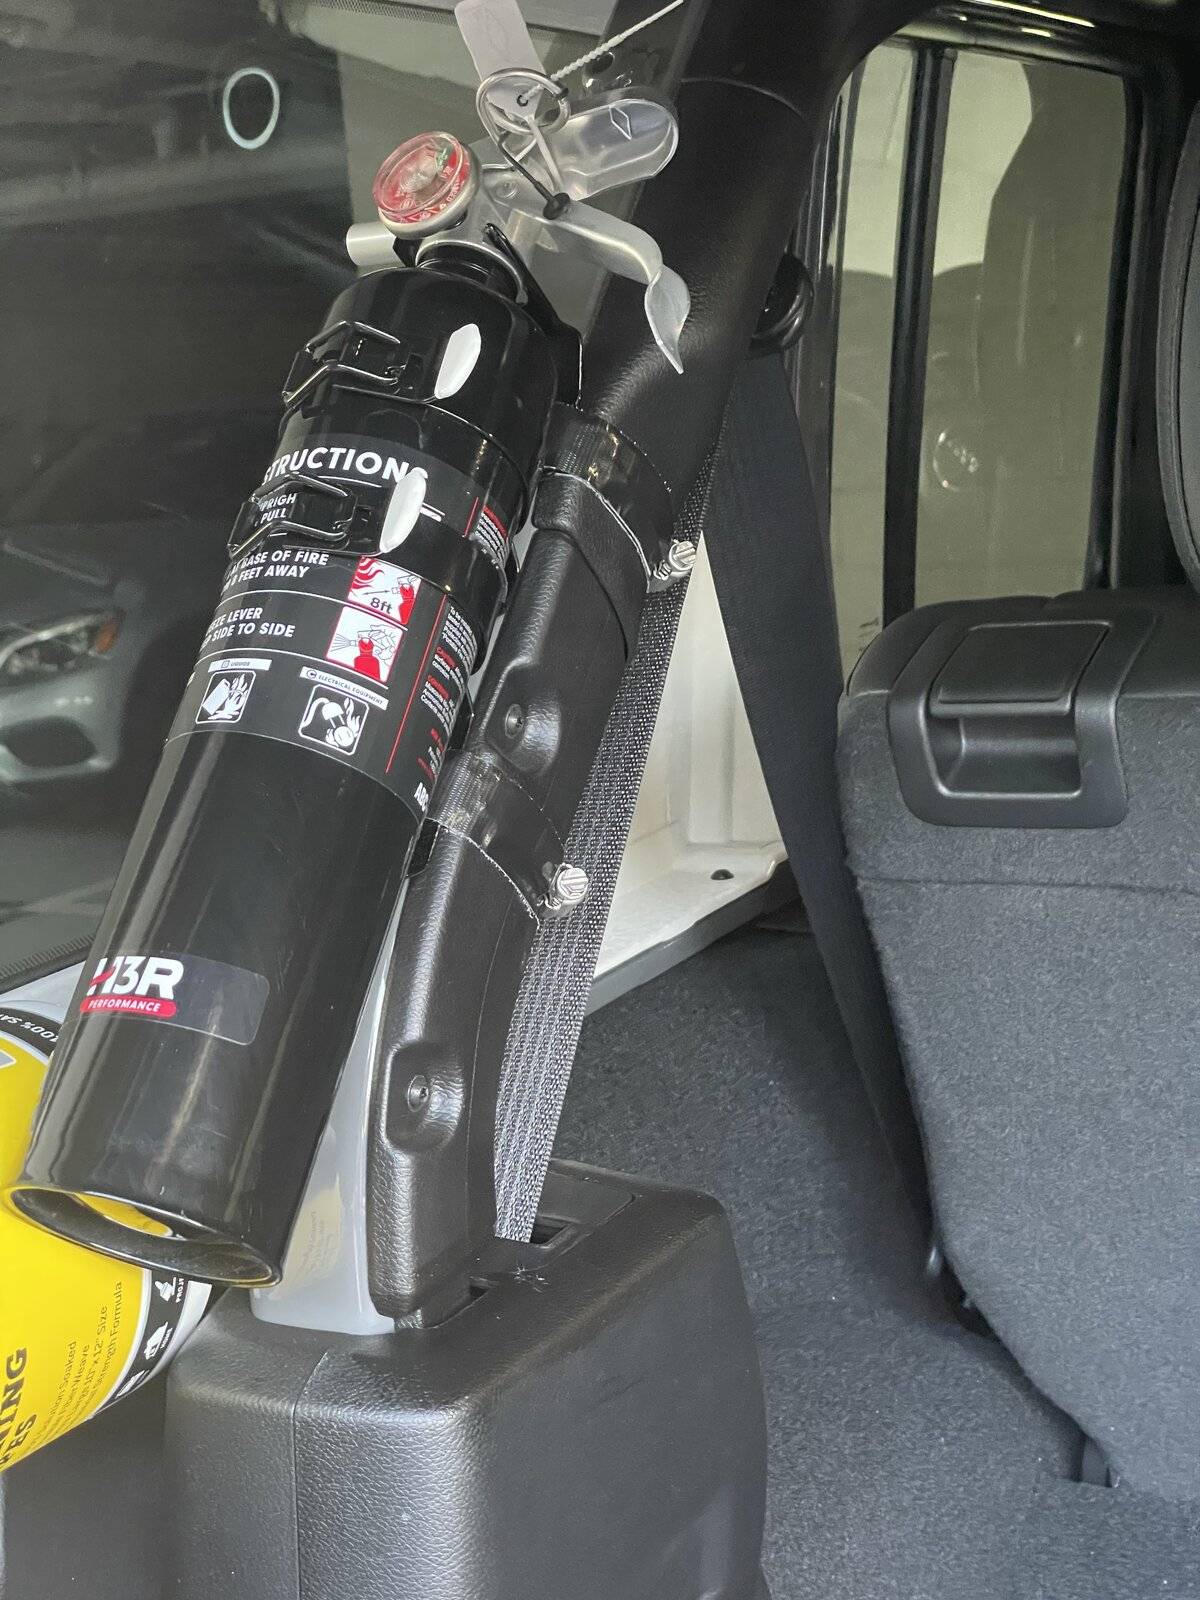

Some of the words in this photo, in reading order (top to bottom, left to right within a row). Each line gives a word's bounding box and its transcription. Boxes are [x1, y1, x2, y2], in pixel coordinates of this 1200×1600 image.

[261, 446, 428, 486] STRUCTION
[260, 509, 287, 525] PULL
[271, 550, 292, 562] OF
[294, 551, 330, 566] FIRE
[263, 564, 310, 578] AWAY
[370, 597, 392, 614] 8ft
[227, 607, 264, 624] LEVER
[211, 624, 236, 642] SIDE
[237, 622, 256, 635] TO
[259, 622, 296, 638] SIDE
[318, 674, 351, 690] ELECTRICAL
[351, 687, 383, 705] EQUIPMENT
[87, 998, 161, 1012] PERFORMANCE
[109, 1280, 122, 1336] Formula
